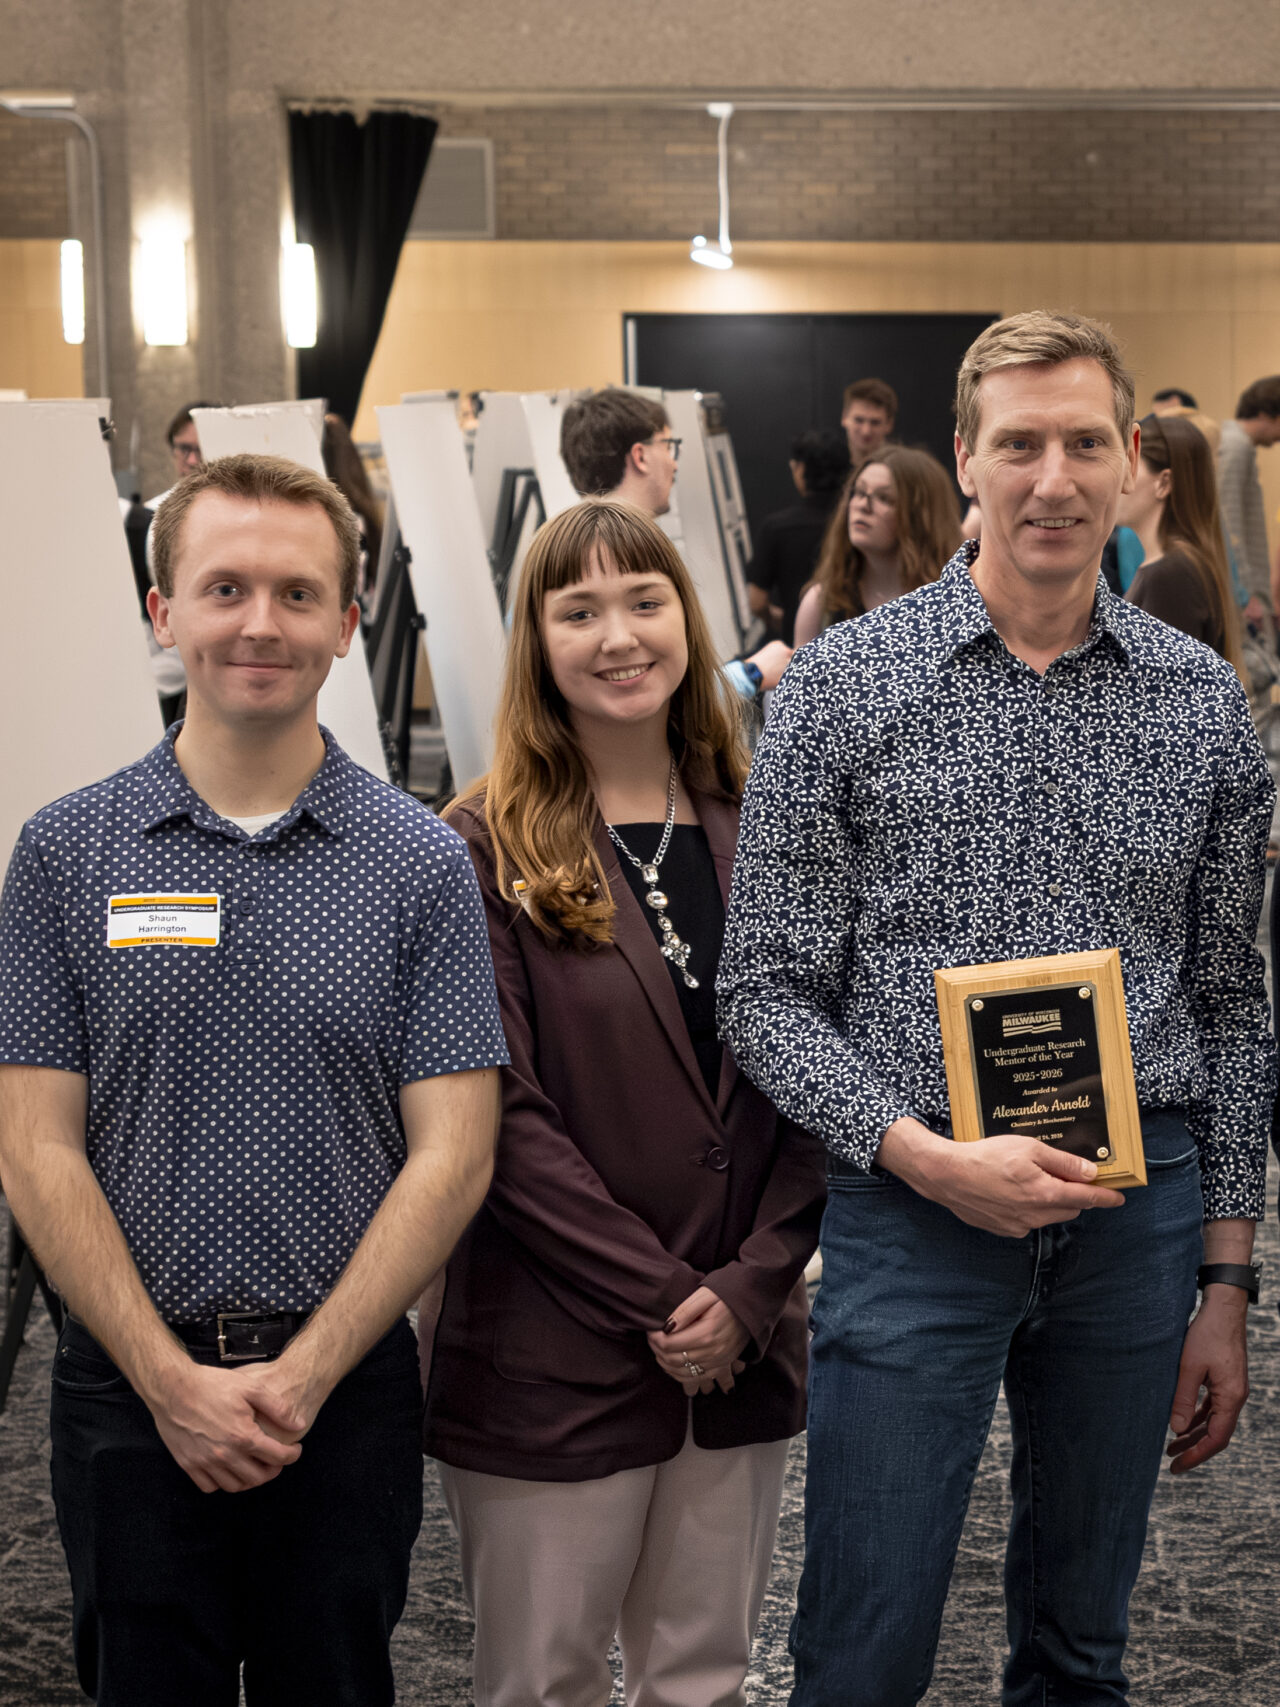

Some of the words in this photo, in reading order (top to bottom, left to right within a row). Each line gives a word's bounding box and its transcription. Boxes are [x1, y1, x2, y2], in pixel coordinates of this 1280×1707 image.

[138, 925, 186, 933] Harrington
[1002, 1013, 1061, 1027] MILWAUKEE
[984, 1045, 1045, 1058] Undergraduate
[1048, 1038, 1086, 1050] Research
[995, 1057, 1026, 1066] Mentor
[1028, 1053, 1037, 1062] of
[1039, 1052, 1052, 1060] the
[1054, 1050, 1074, 1059] Year
[1013, 1068, 1063, 1082] 2025-2026
[1022, 1087, 1050, 1096] Awarded
[992, 1101, 1049, 1119] Alexander
[1051, 1095, 1091, 1111] Arnold
[1011, 1120, 1036, 1128] Chemistry
